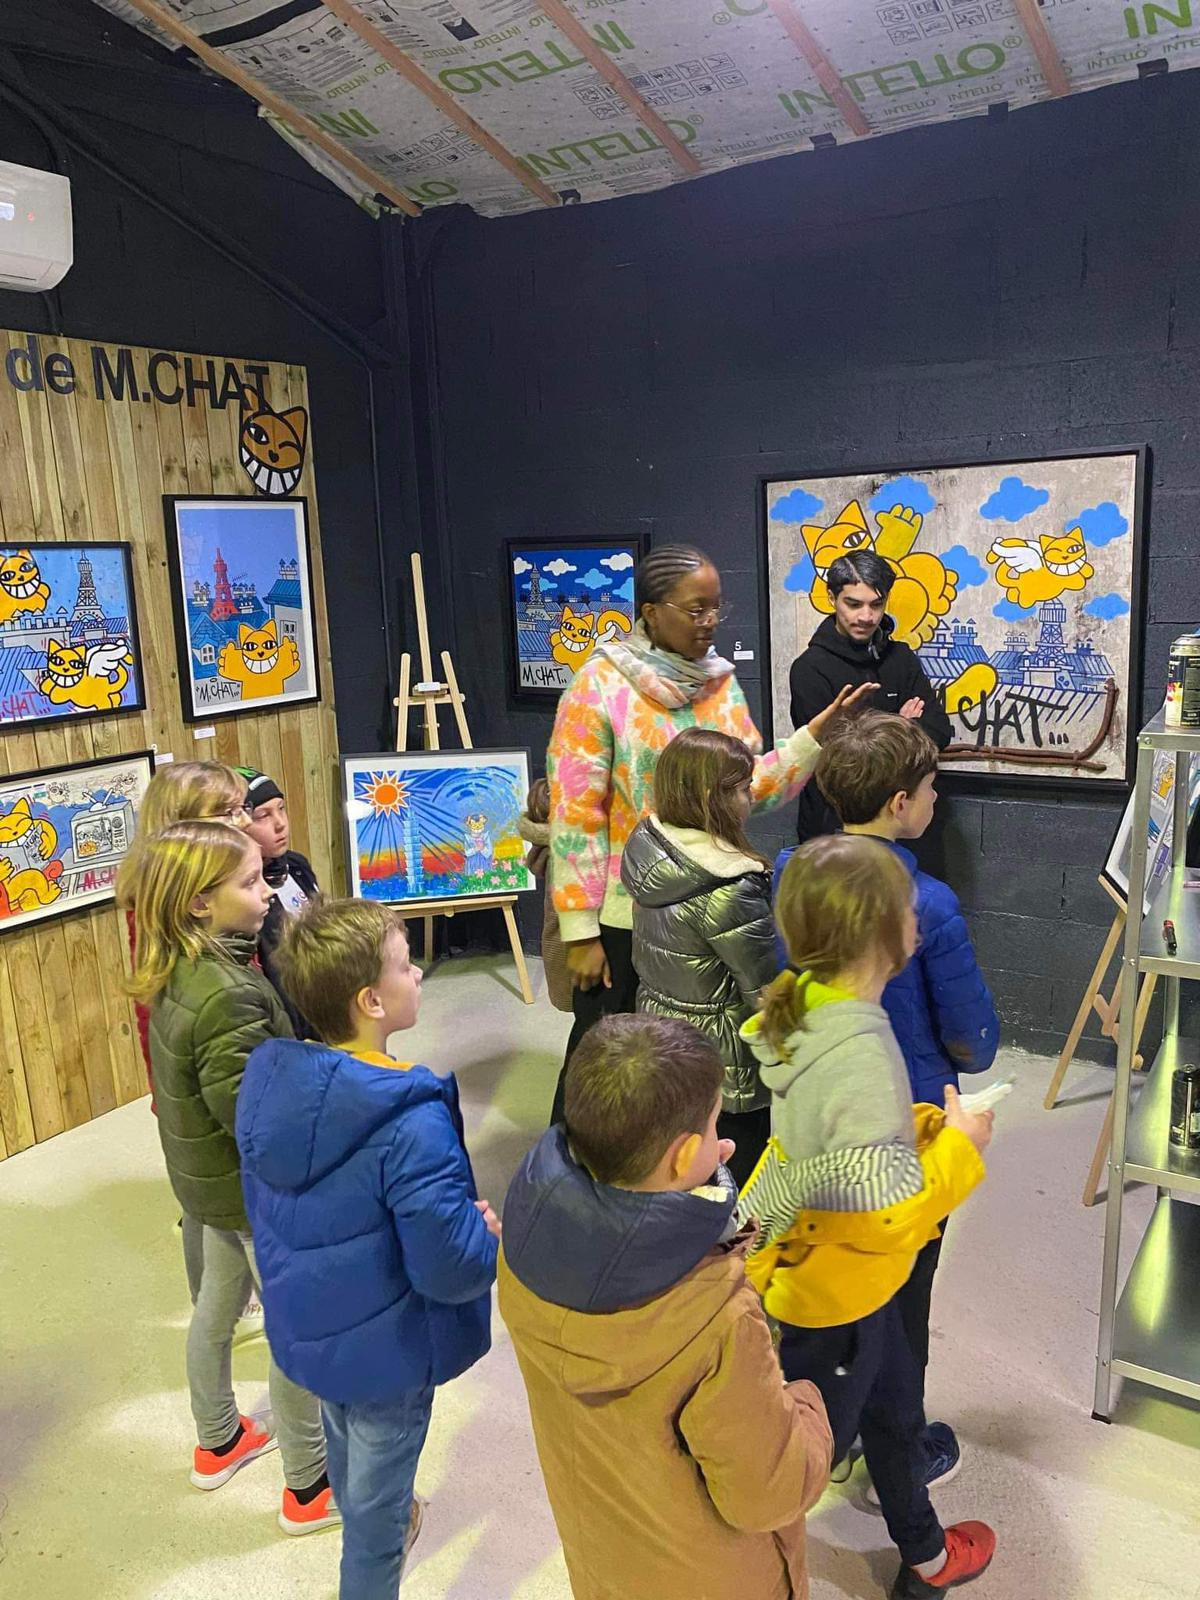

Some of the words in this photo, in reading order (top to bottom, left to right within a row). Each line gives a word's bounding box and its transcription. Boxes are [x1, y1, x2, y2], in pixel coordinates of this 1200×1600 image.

[5, 334, 77, 395] de
[91, 346, 270, 412] M.CHAT
[734, 641, 742, 651] 5
